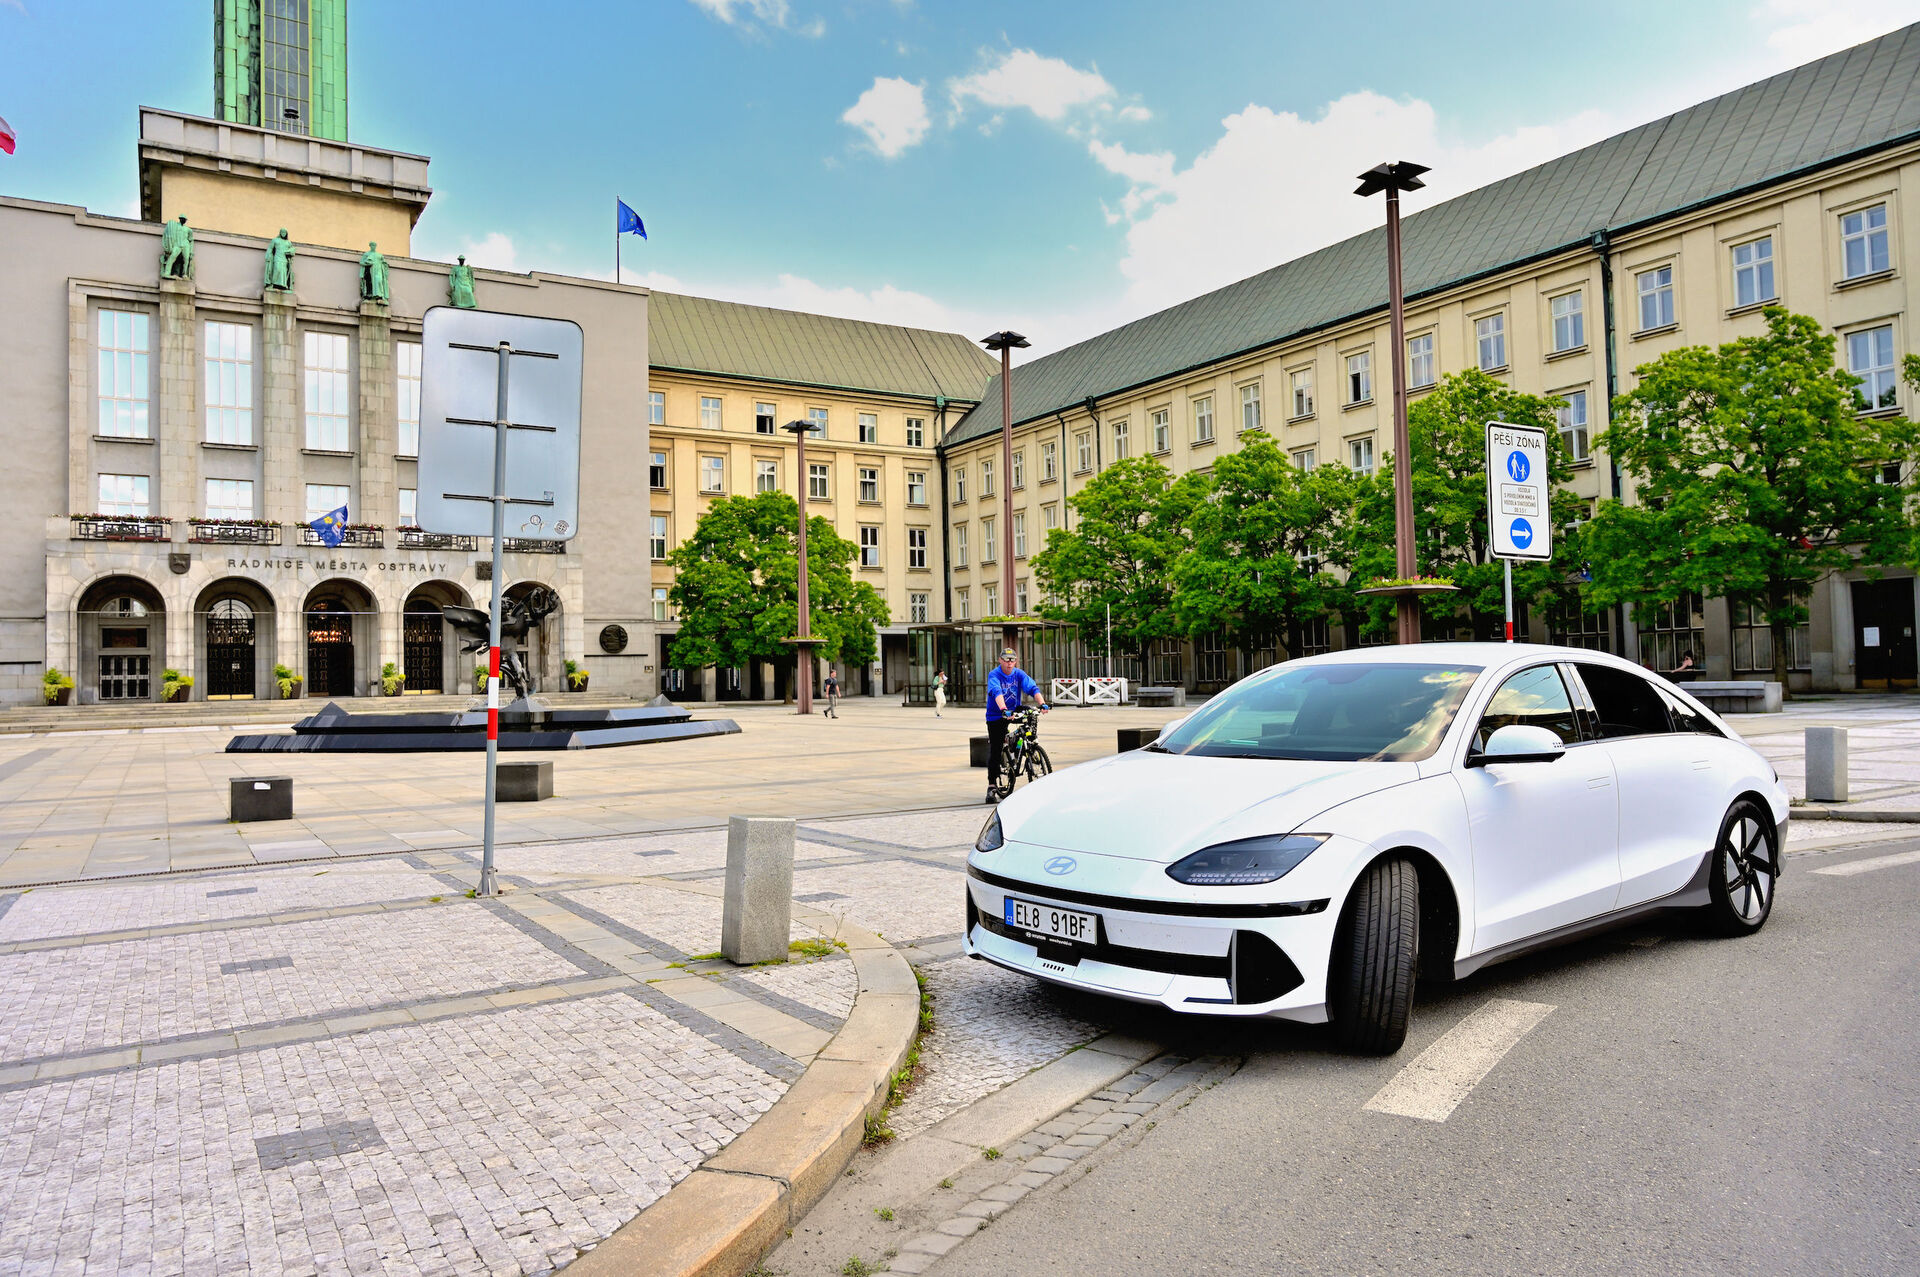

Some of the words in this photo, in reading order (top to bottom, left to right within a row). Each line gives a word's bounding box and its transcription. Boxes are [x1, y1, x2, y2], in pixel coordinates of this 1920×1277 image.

[1494, 431, 1513, 446] PĚŠÍ
[1516, 434, 1541, 449] ZÓNA
[228, 559, 303, 570] RADNICE
[316, 559, 367, 571] MĚSTA
[378, 562, 447, 572] OSTRAVY
[1016, 904, 1040, 928] EL8
[1051, 911, 1087, 938] 91BF
